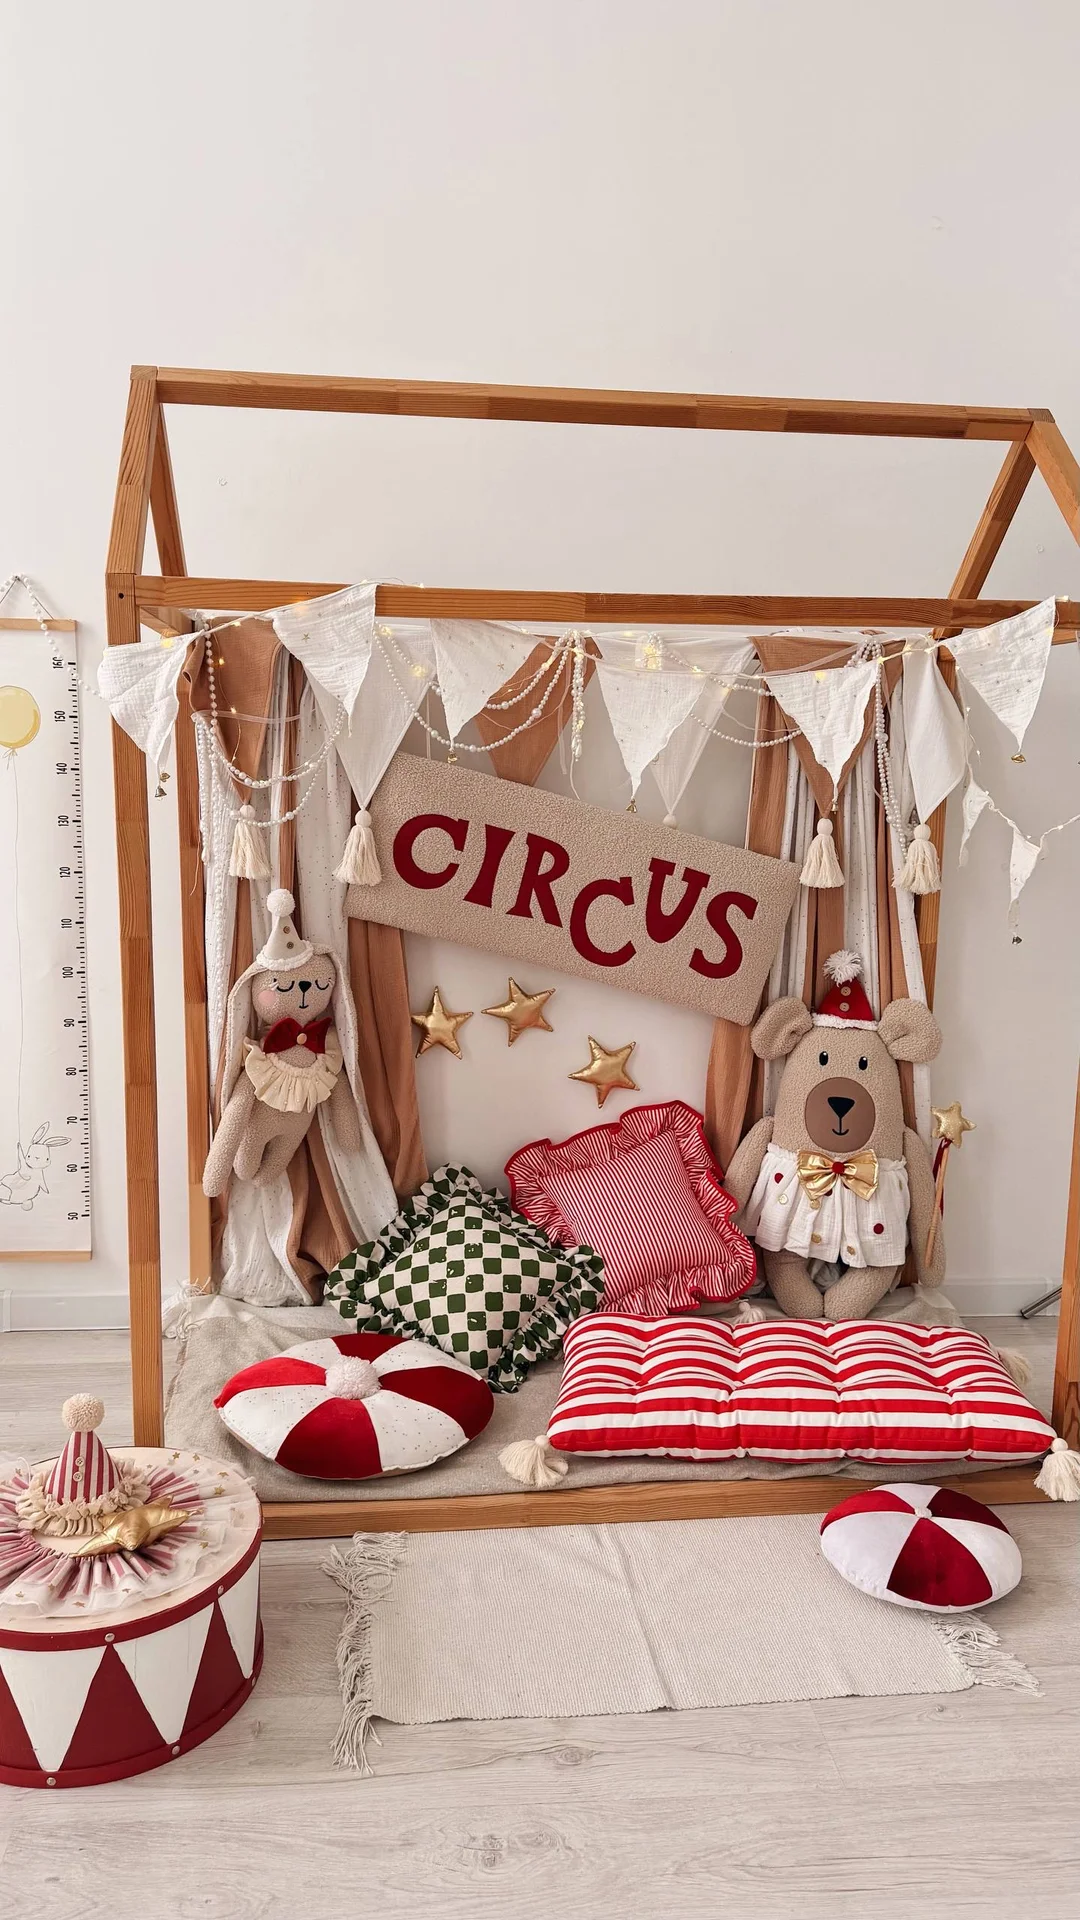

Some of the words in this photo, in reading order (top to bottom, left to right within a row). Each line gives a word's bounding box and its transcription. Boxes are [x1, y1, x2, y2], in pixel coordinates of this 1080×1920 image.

[54, 710, 66, 722] 150
[56, 762, 67, 775] 140
[57, 815, 69, 826] 130
[59, 866, 71, 878] 120
[393, 813, 758, 979] CIRCUS
[61, 918, 72, 928] 110
[62, 966, 74, 978] 100
[63, 1018, 75, 1027] 90
[66, 1067, 77, 1076] 80
[67, 1116, 77, 1124] 70
[67, 1164, 77, 1172] 60
[68, 1212, 78, 1220] 50
